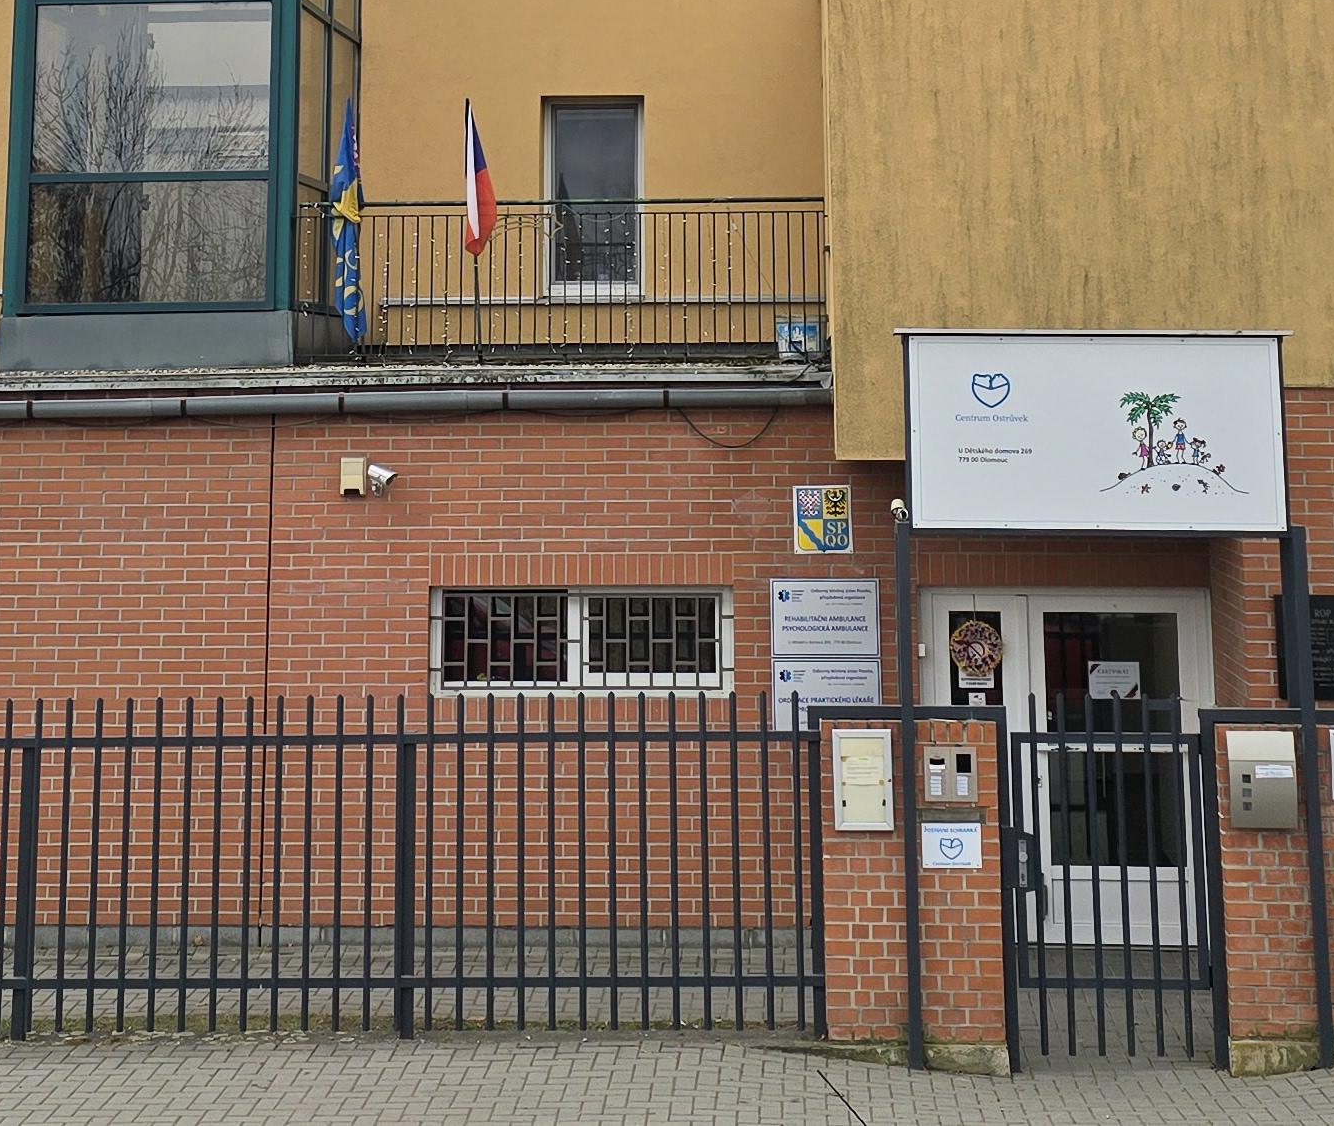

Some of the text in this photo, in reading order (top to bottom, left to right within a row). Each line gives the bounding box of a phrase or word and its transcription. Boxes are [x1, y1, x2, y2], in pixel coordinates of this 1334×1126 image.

[955, 413, 1028, 423] Centrum Ostrůvek
[826, 521, 847, 534] SP
[825, 534, 848, 547] QO
